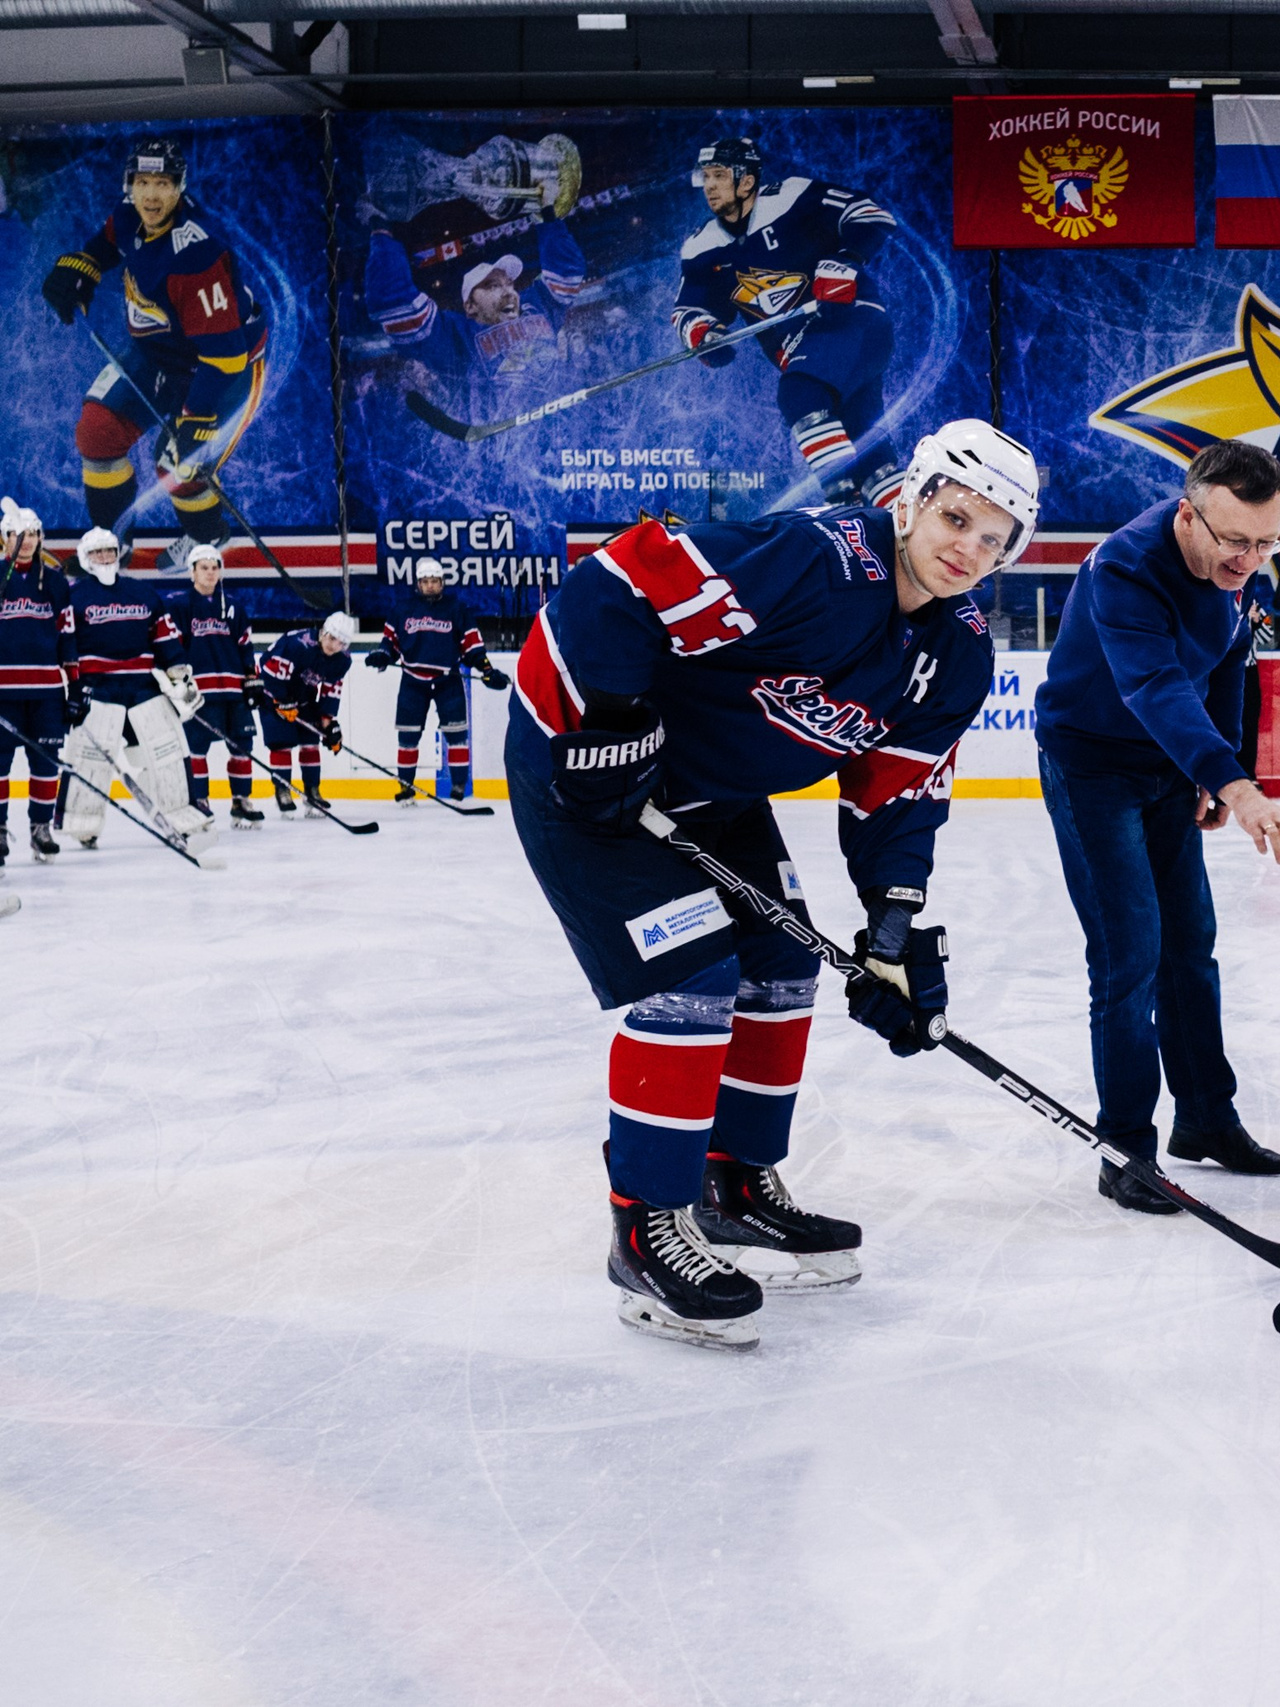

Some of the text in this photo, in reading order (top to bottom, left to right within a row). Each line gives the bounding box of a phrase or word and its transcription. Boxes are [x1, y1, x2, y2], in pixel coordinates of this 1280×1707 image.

[988, 107, 1161, 141] ХОККЕЙ РОССИИ
[821, 188, 854, 209] 10
[198, 281, 229, 318] 14
[561, 449, 616, 467] БЫТЬ
[561, 471, 765, 492] ИГРАТЬ ДО ПОБЕДЫ!
[385, 513, 514, 550] СЕРГЕЙ
[833, 531, 853, 558] MINING
[834, 540, 852, 581] COMPANY
[996, 1073, 1131, 1169] PRIDE
[742, 1214, 787, 1241] BAUER
[641, 1270, 667, 1300] BAUER
